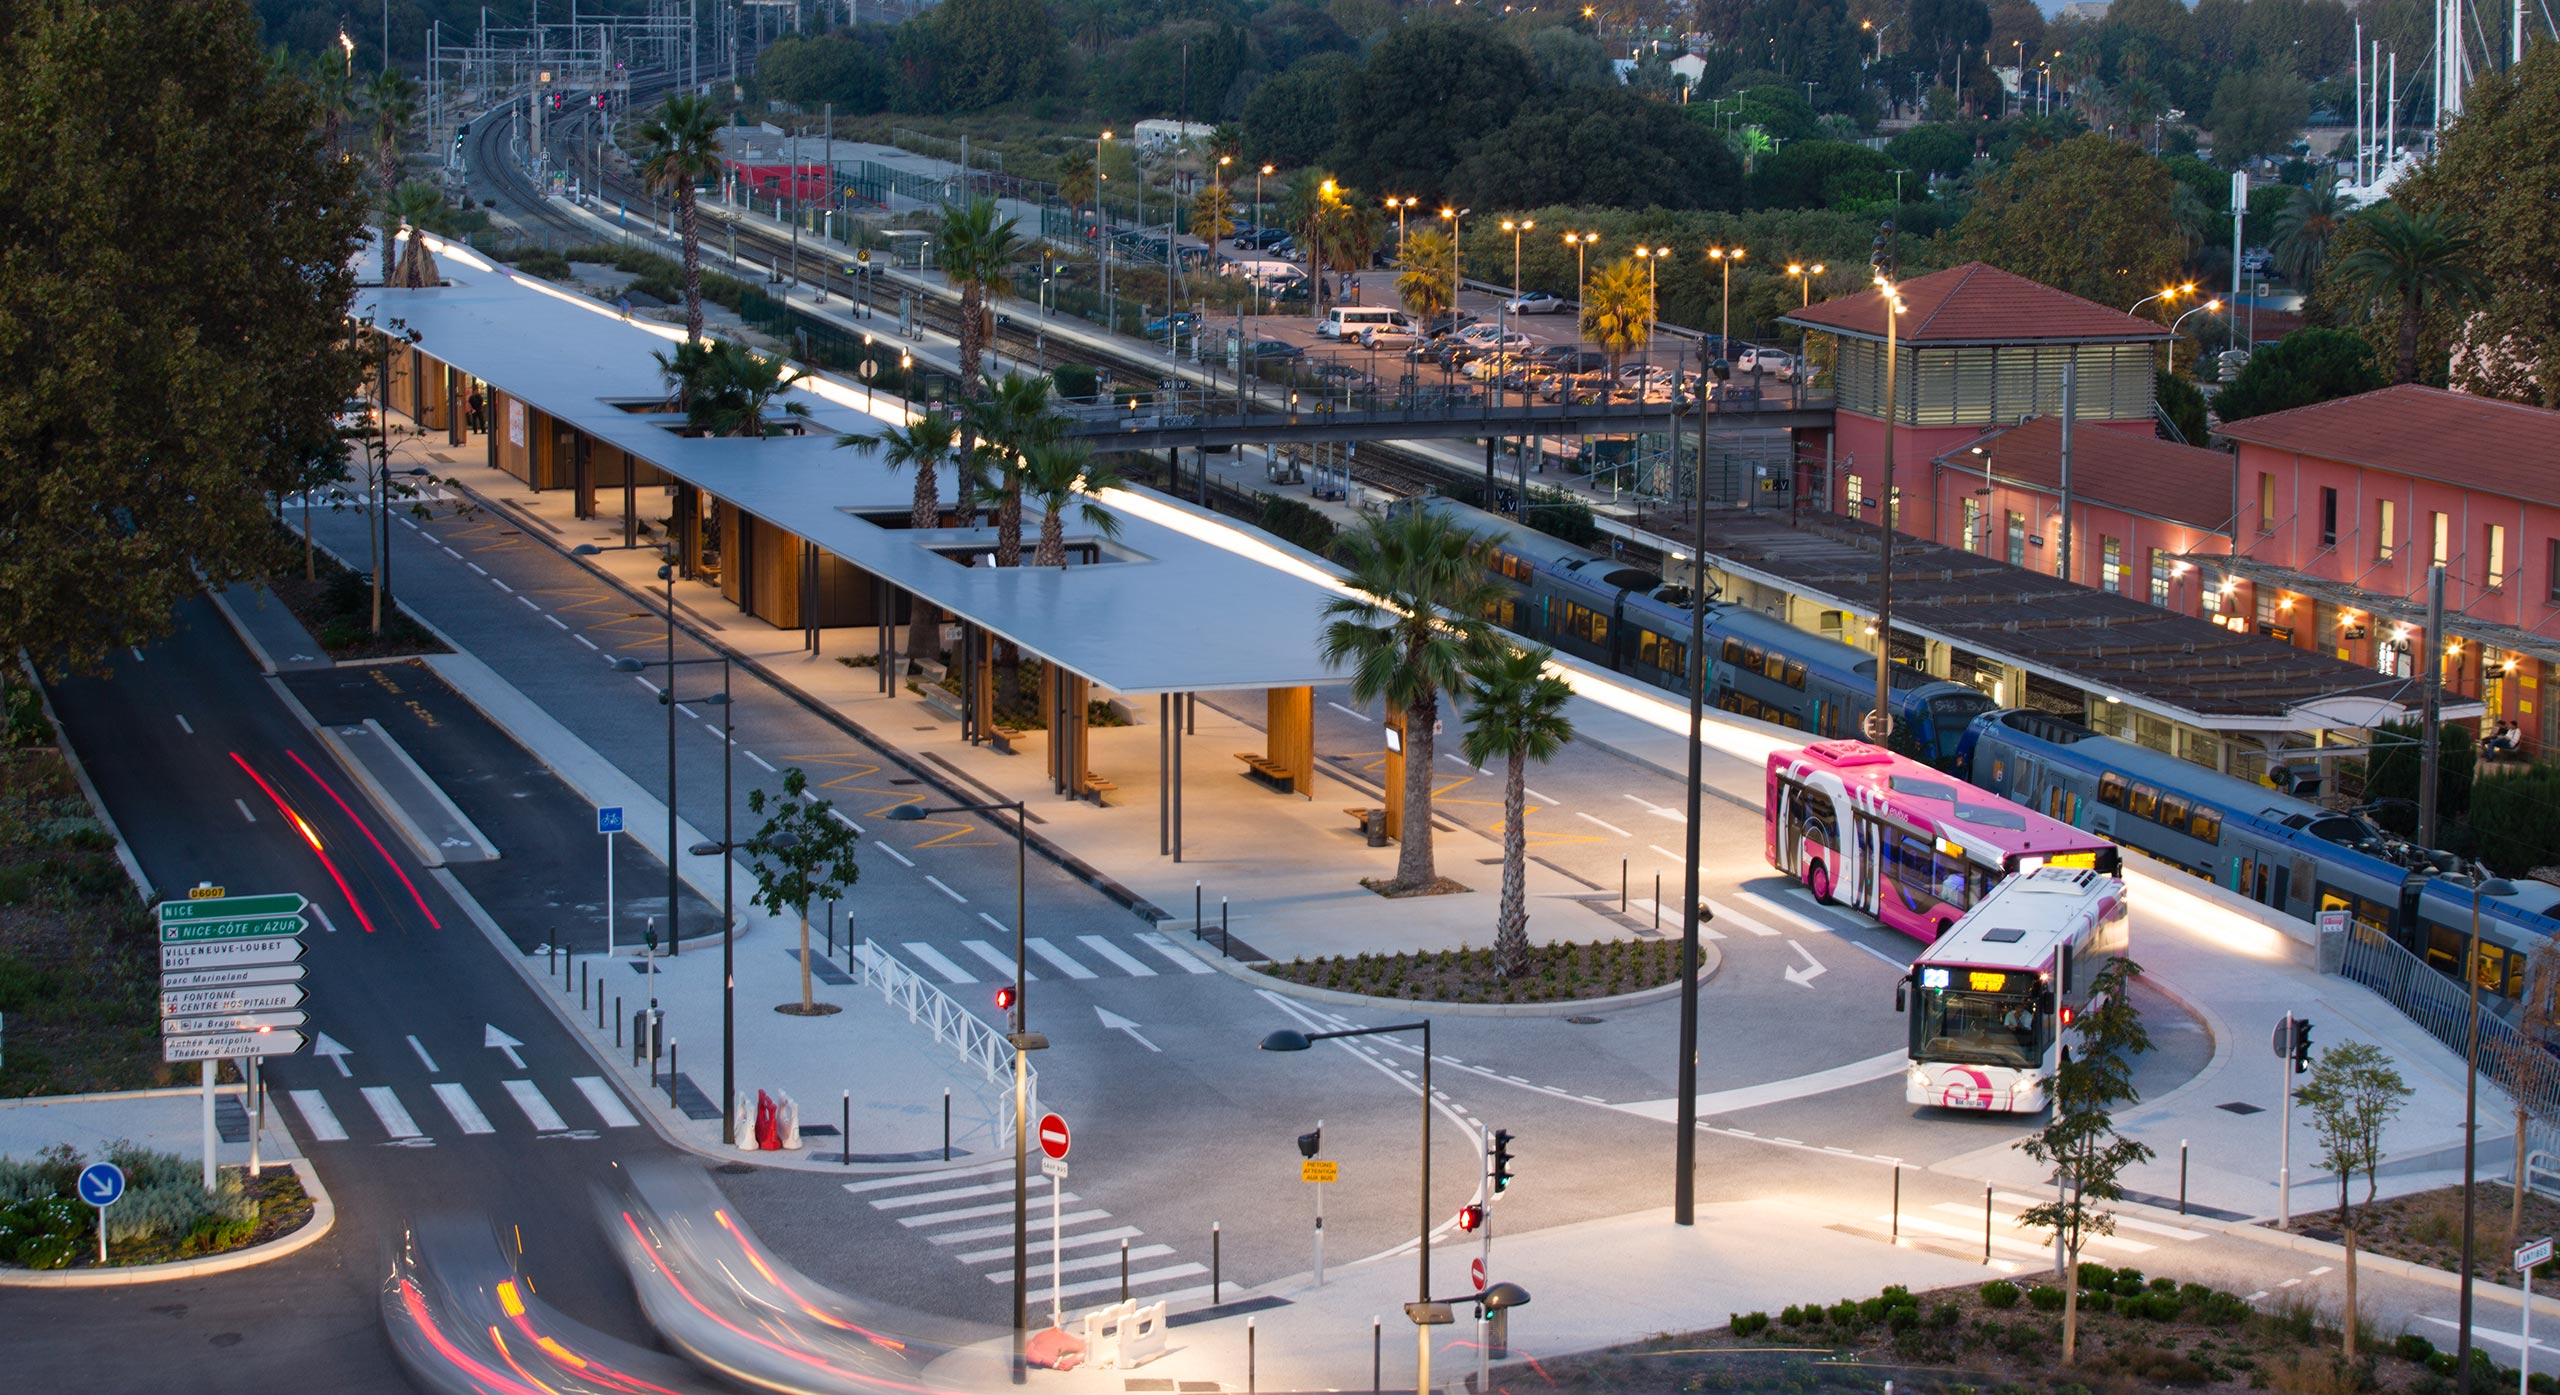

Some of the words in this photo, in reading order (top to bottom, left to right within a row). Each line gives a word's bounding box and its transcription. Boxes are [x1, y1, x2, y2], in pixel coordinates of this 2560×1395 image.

[165, 906, 193, 916] NICE
[183, 922, 248, 936] NICE-CÔTE
[166, 942, 281, 957] VILLENEUVE-LOUBET
[166, 958, 190, 966] BIOT
[166, 976, 188, 986] parc
[192, 972, 248, 983] Marineland
[167, 993, 178, 1002] LA
[184, 991, 236, 1001] FONTONNE
[181, 1001, 218, 1011] CENTRE
[223, 998, 286, 1008] HOSPITALIER
[208, 1018, 241, 1028] Brague
[208, 1036, 252, 1046] Antipolis
[215, 1045, 261, 1055] d'Antibes
[2522, 1247, 2547, 1263] ANTIBES
